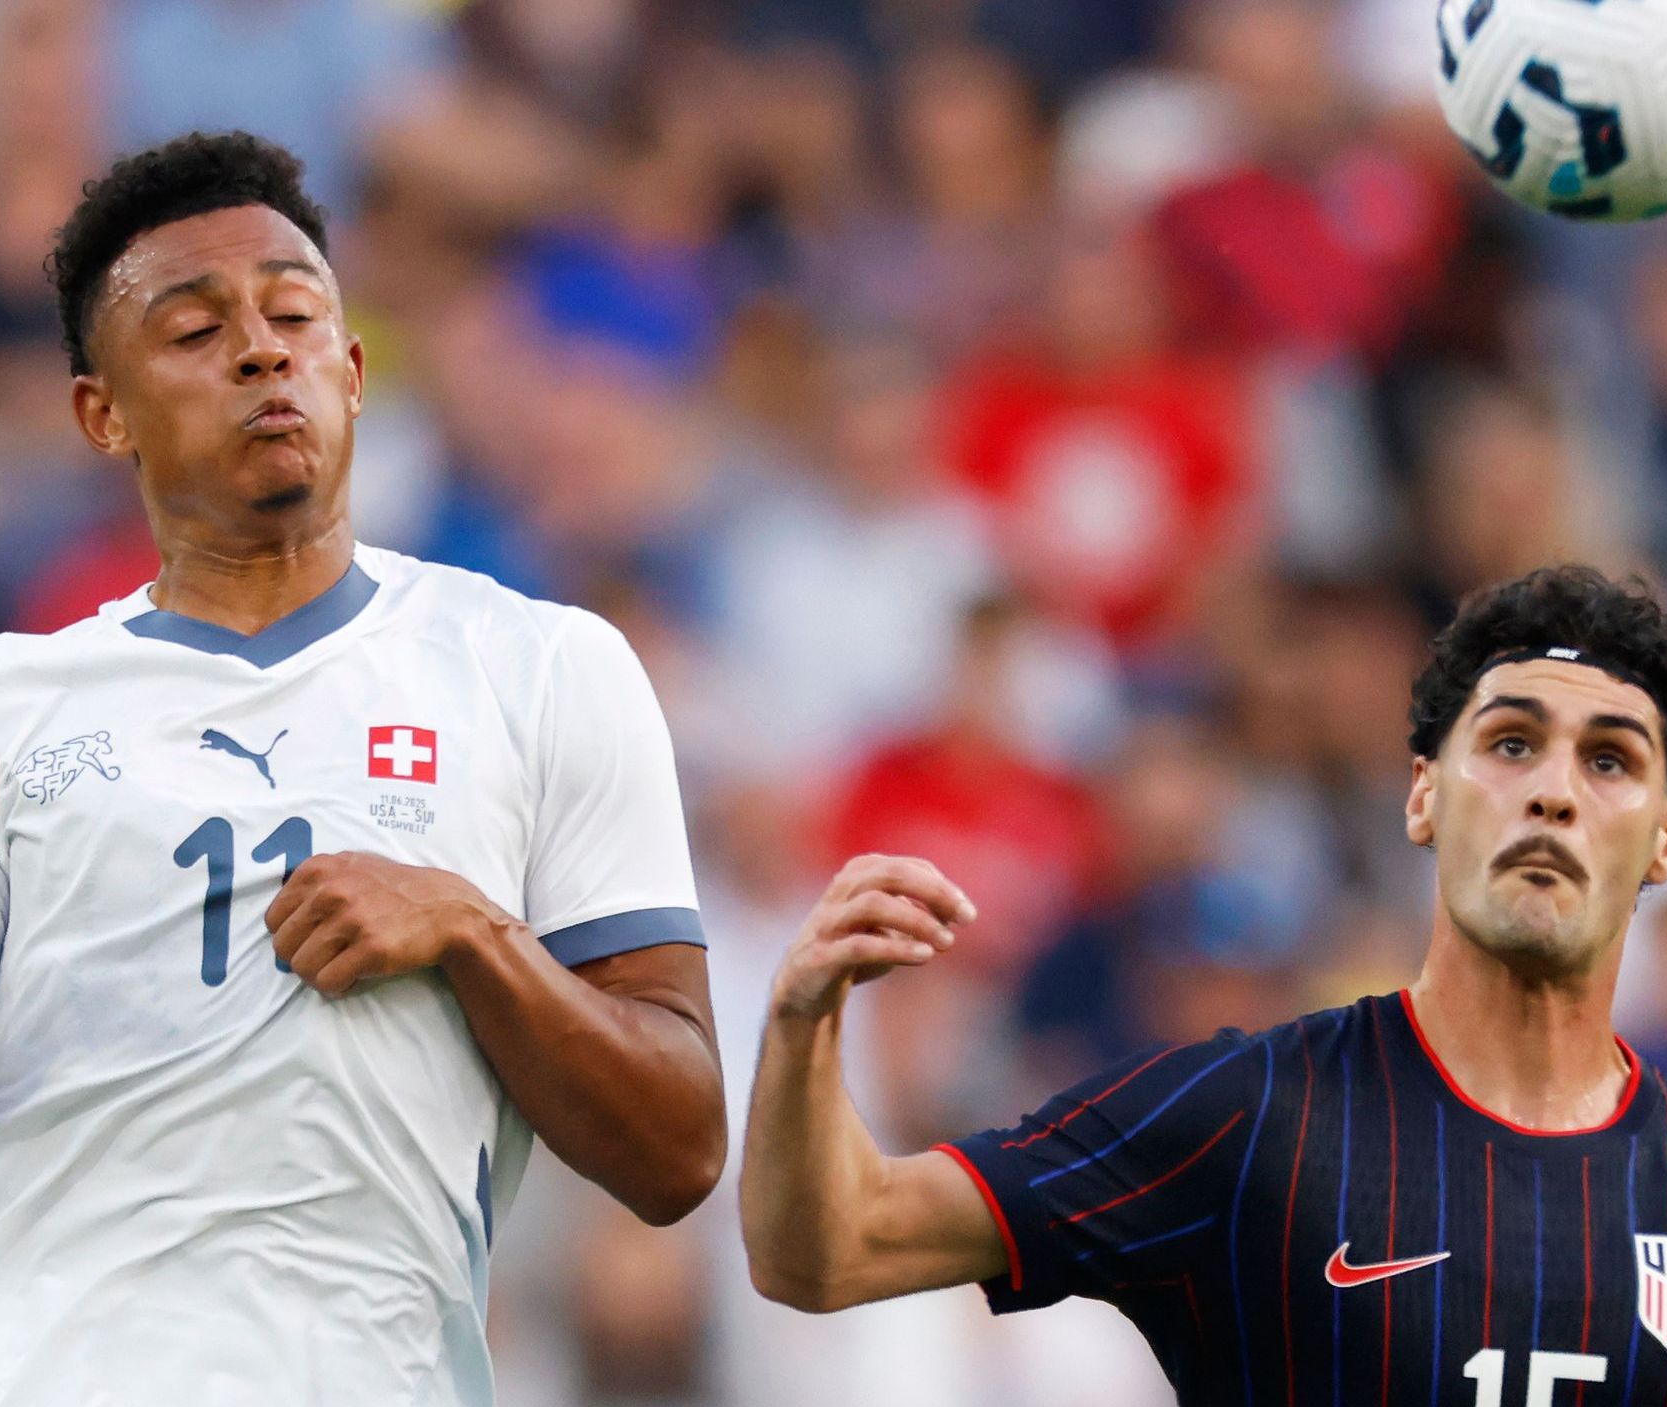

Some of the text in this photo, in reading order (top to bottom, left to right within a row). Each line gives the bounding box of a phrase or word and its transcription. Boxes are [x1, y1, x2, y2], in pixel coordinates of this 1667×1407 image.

[370, 803, 396, 818] USA
[414, 808, 435, 825] SUI
[377, 818, 427, 835] NASHVILLE
[173, 816, 313, 987] 11
